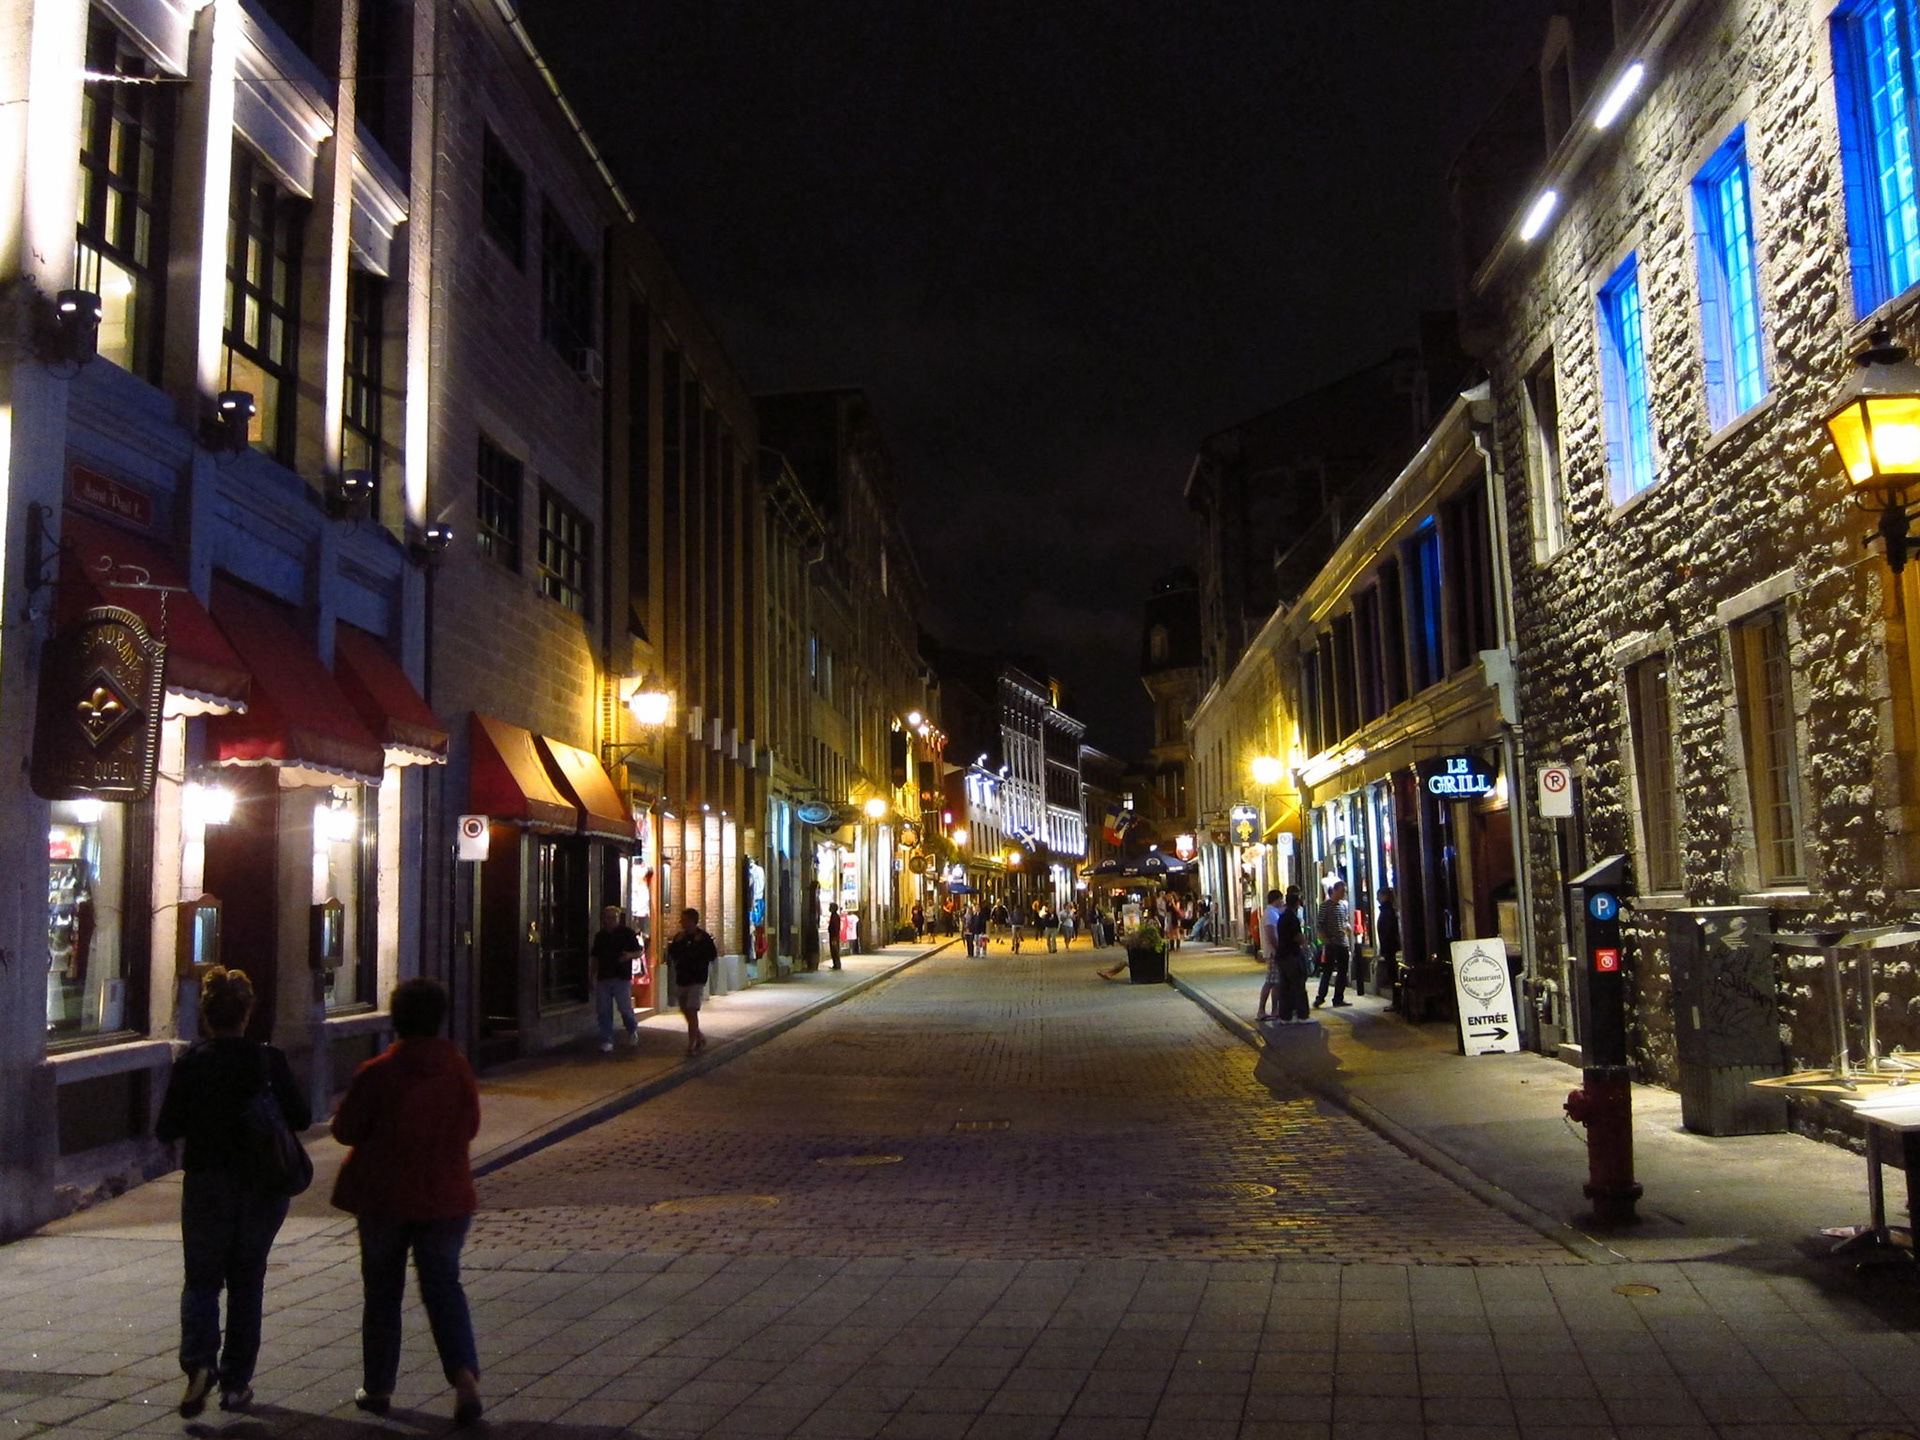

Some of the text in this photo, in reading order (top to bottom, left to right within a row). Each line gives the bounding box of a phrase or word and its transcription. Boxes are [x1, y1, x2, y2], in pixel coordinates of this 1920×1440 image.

[1446, 758, 1469, 774] LE
[1428, 774, 1491, 794] GRILL
[1463, 975, 1502, 983] Restaurant
[1468, 1013, 1509, 1026] ENTRÉE
